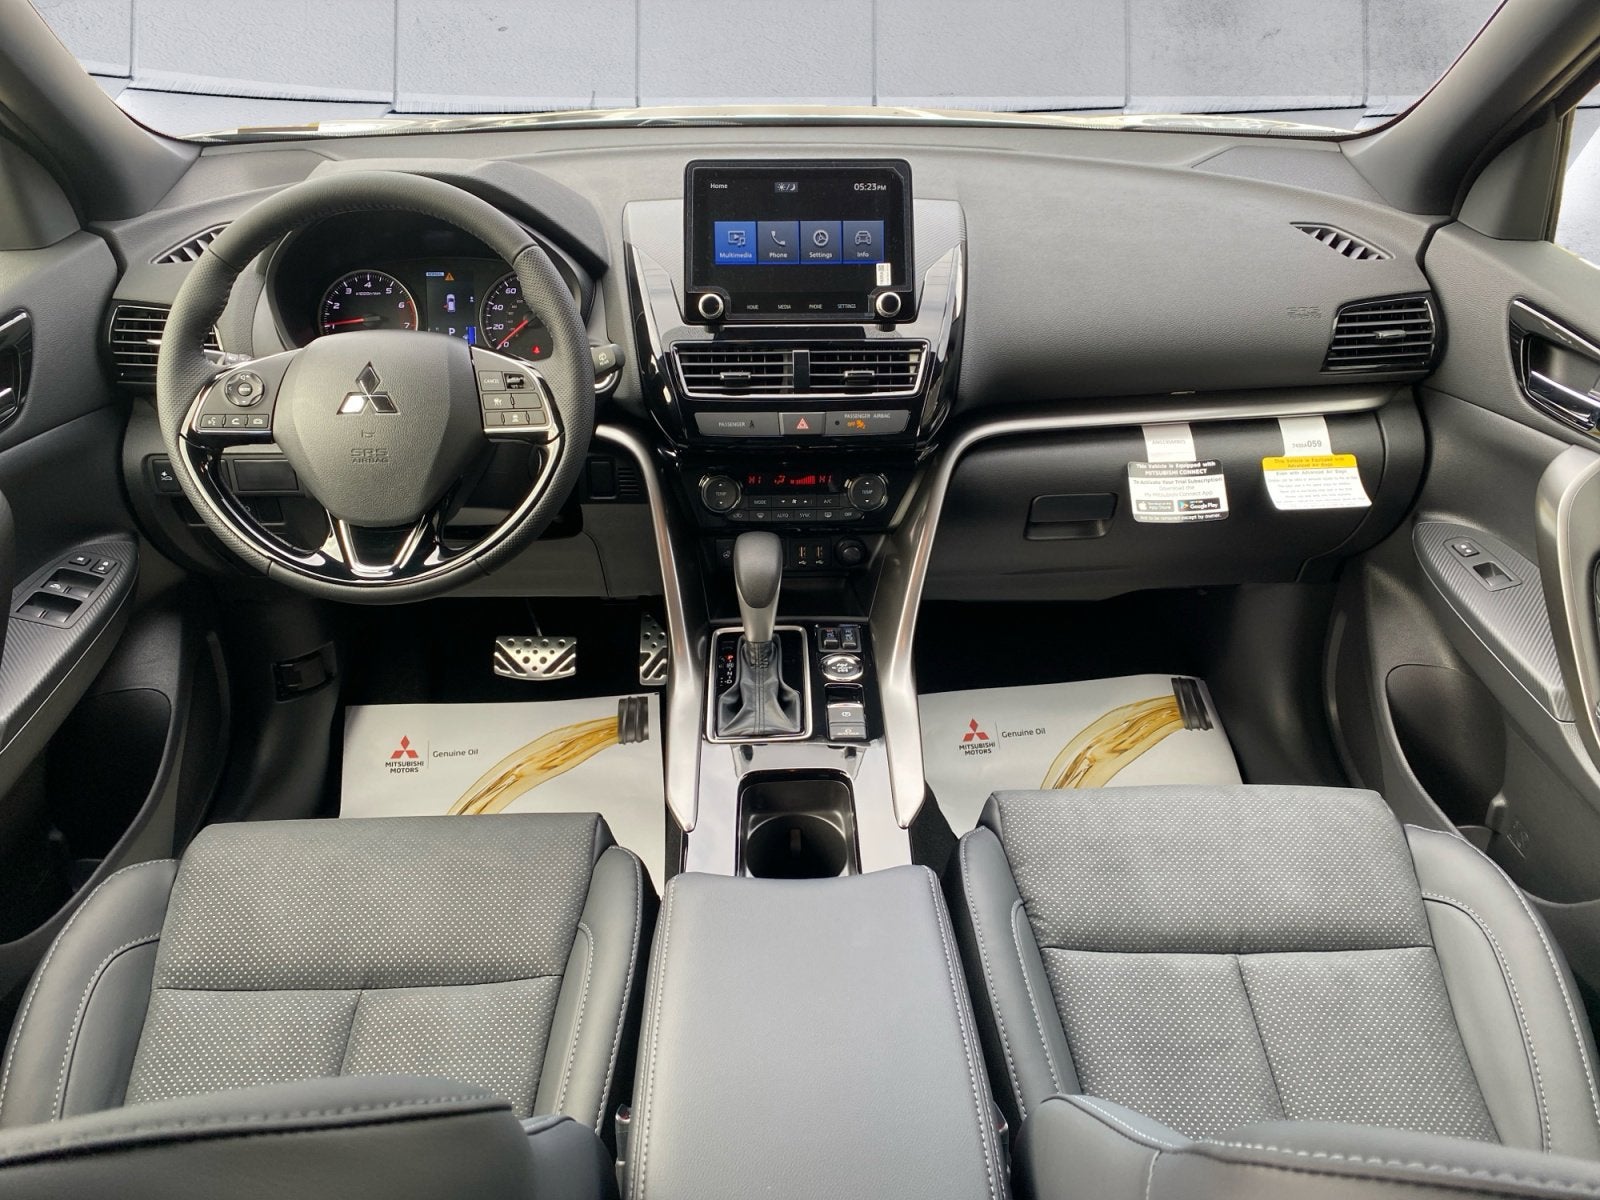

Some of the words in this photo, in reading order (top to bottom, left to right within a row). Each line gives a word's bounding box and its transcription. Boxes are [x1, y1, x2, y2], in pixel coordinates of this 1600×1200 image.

[710, 182, 728, 190] Home
[853, 183, 887, 191] 05:23PM
[809, 252, 833, 260] Settings
[345, 287, 352, 295] 3
[398, 301, 405, 309] 6
[403, 321, 410, 329] 7
[448, 327, 456, 336] P
[350, 448, 388, 456] SRS
[1175, 462, 1201, 470] Equipped
[1188, 477, 1222, 485] Subscription
[1002, 729, 1034, 738] Genuine
[1035, 727, 1046, 736] Oil
[959, 742, 996, 750] MITSUBISHI
[433, 750, 466, 758] Genuine
[467, 748, 479, 756] Oil
[964, 748, 992, 756] MOTORS
